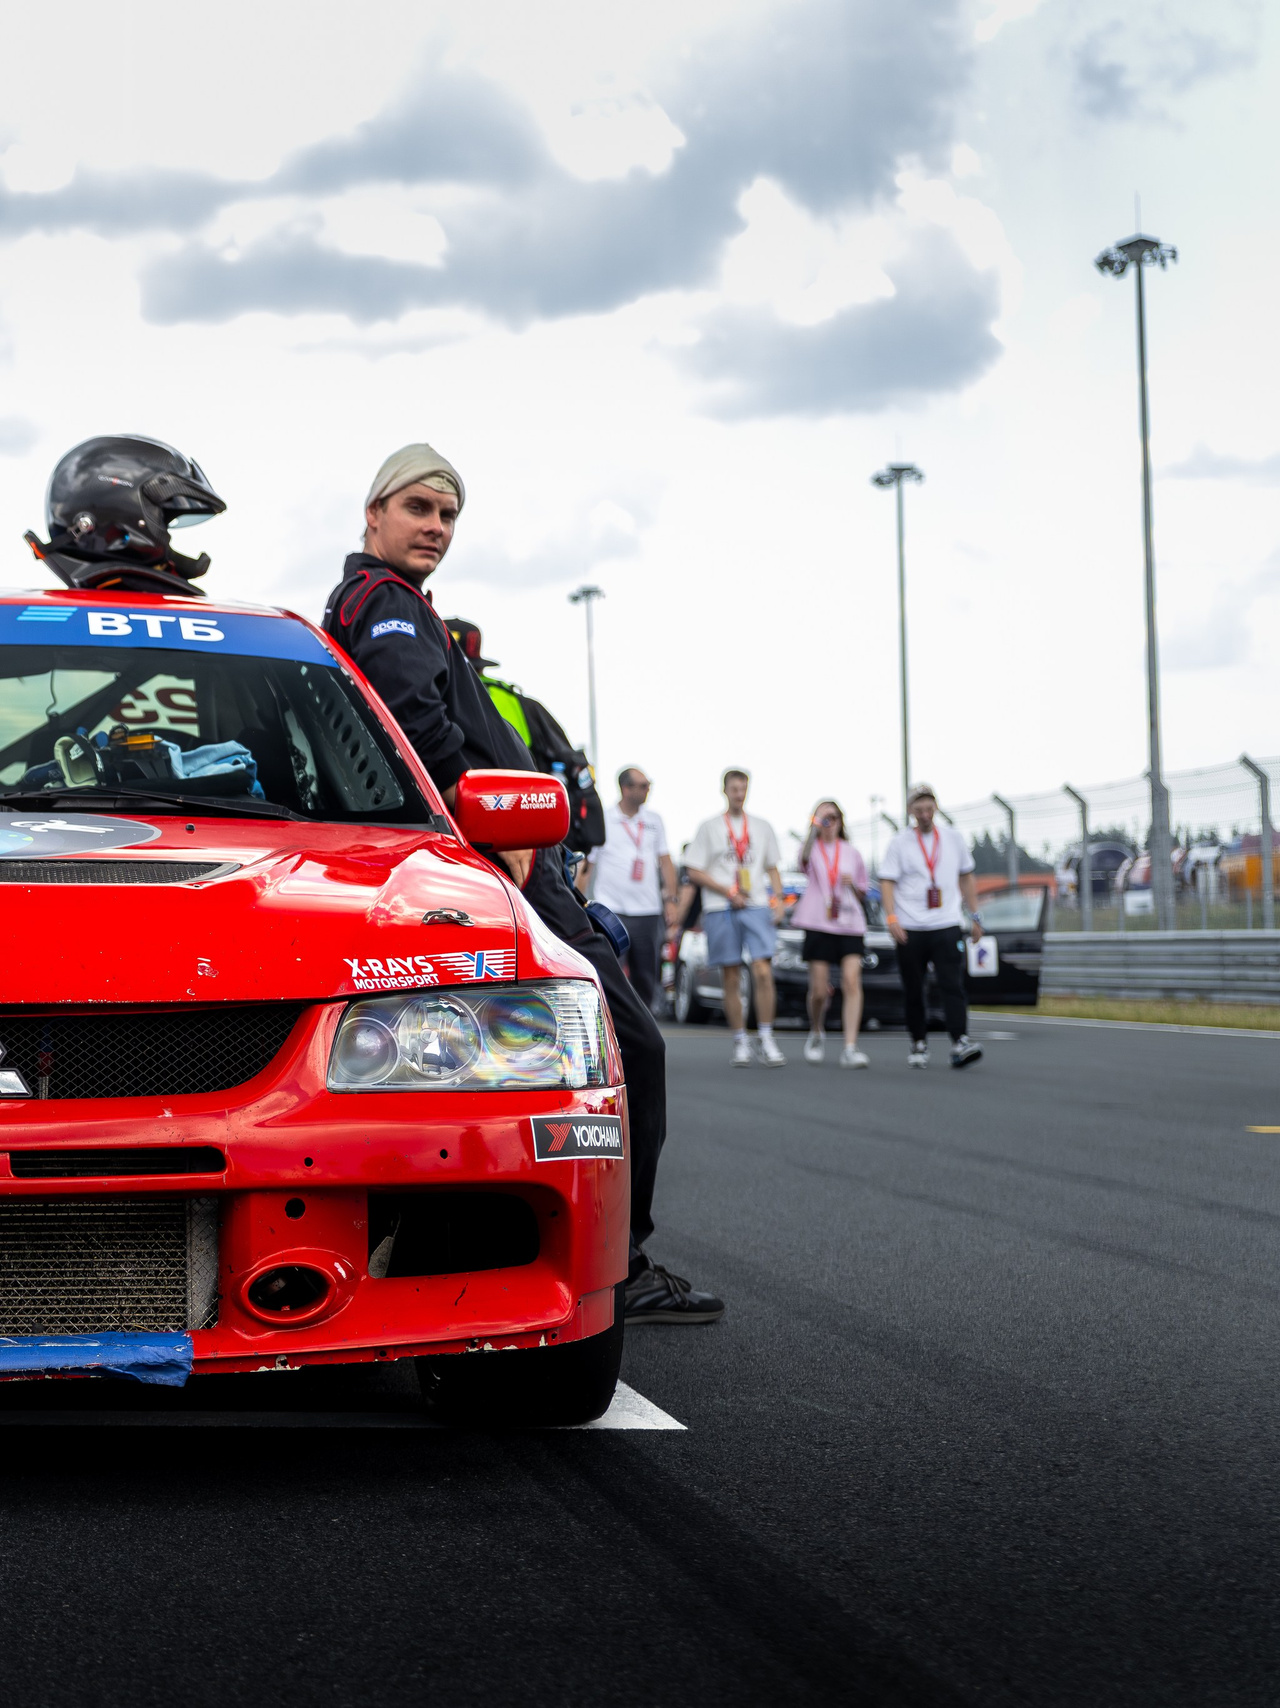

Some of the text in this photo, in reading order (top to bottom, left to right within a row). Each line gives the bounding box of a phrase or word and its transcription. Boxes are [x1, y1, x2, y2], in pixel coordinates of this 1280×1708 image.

[87, 612, 225, 642] ВТБ
[343, 955, 434, 978] X-RAYS
[353, 973, 440, 990] MOTORSPORT
[572, 1125, 621, 1148] YOKOHAMA
